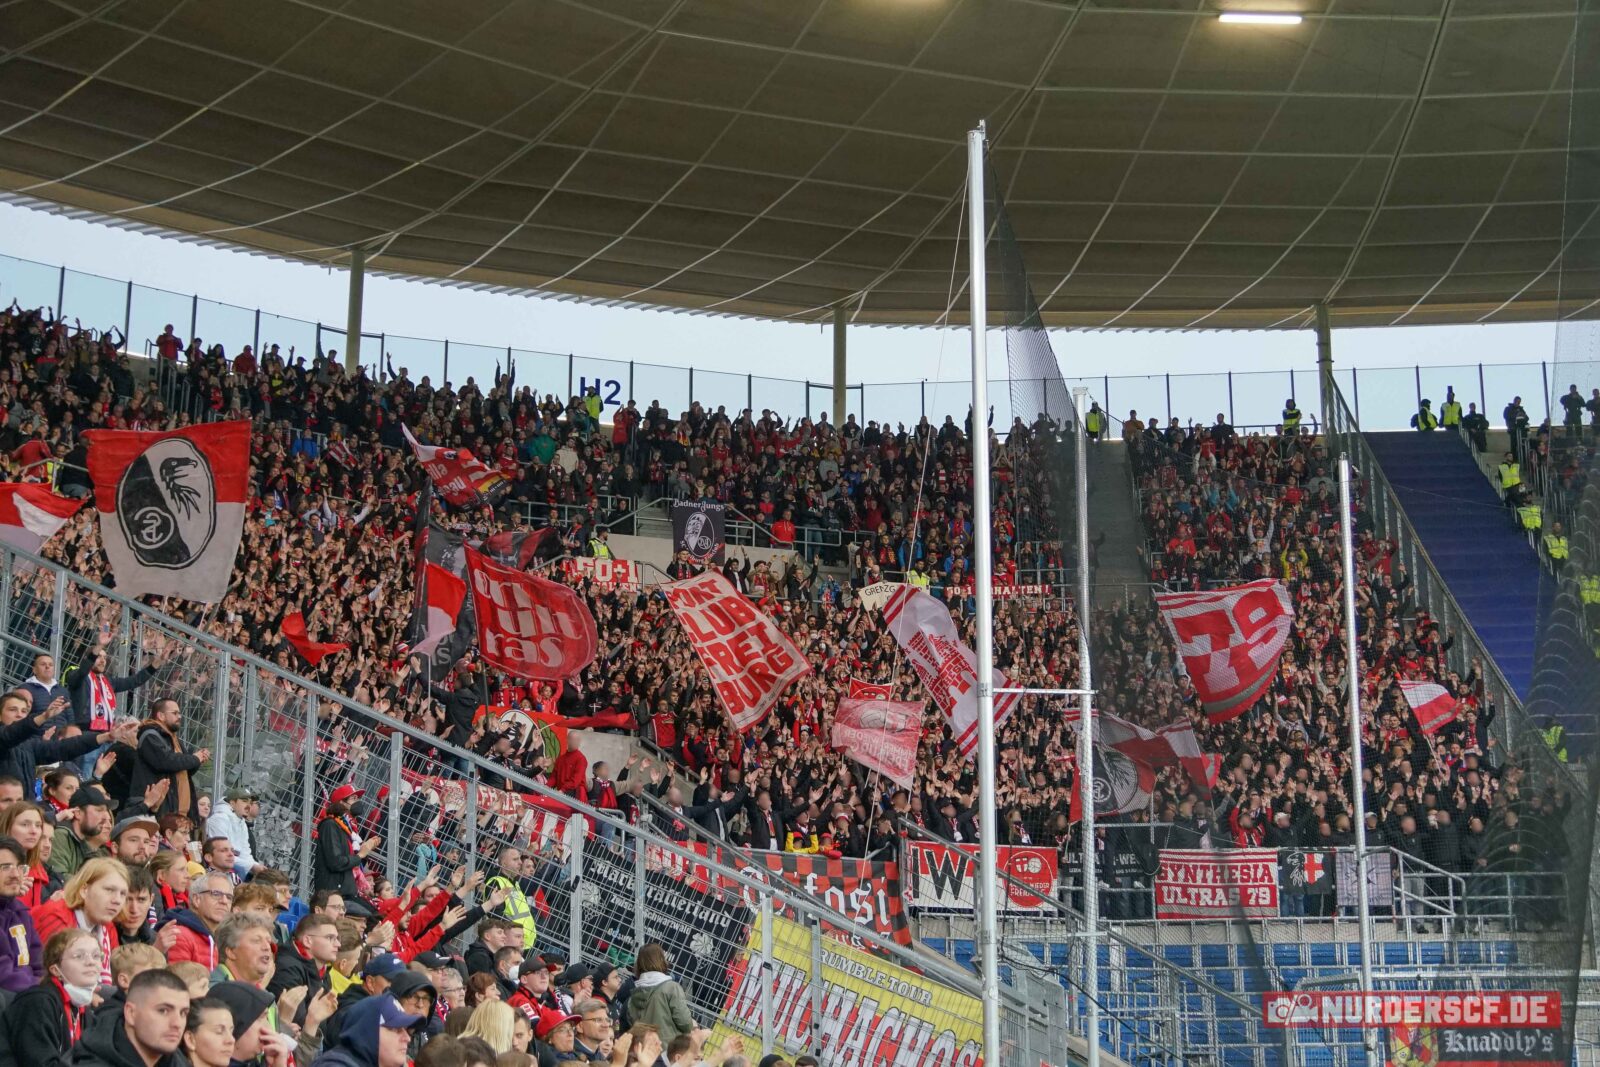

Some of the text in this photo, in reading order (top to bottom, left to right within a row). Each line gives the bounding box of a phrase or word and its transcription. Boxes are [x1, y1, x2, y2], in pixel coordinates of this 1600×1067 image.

[580, 376, 621, 405] H2
[716, 646, 794, 715] BURG
[1156, 862, 1274, 884] SYNTHESIA
[1162, 887, 1241, 906] ULTRAS
[887, 975, 933, 1006] TOUR
